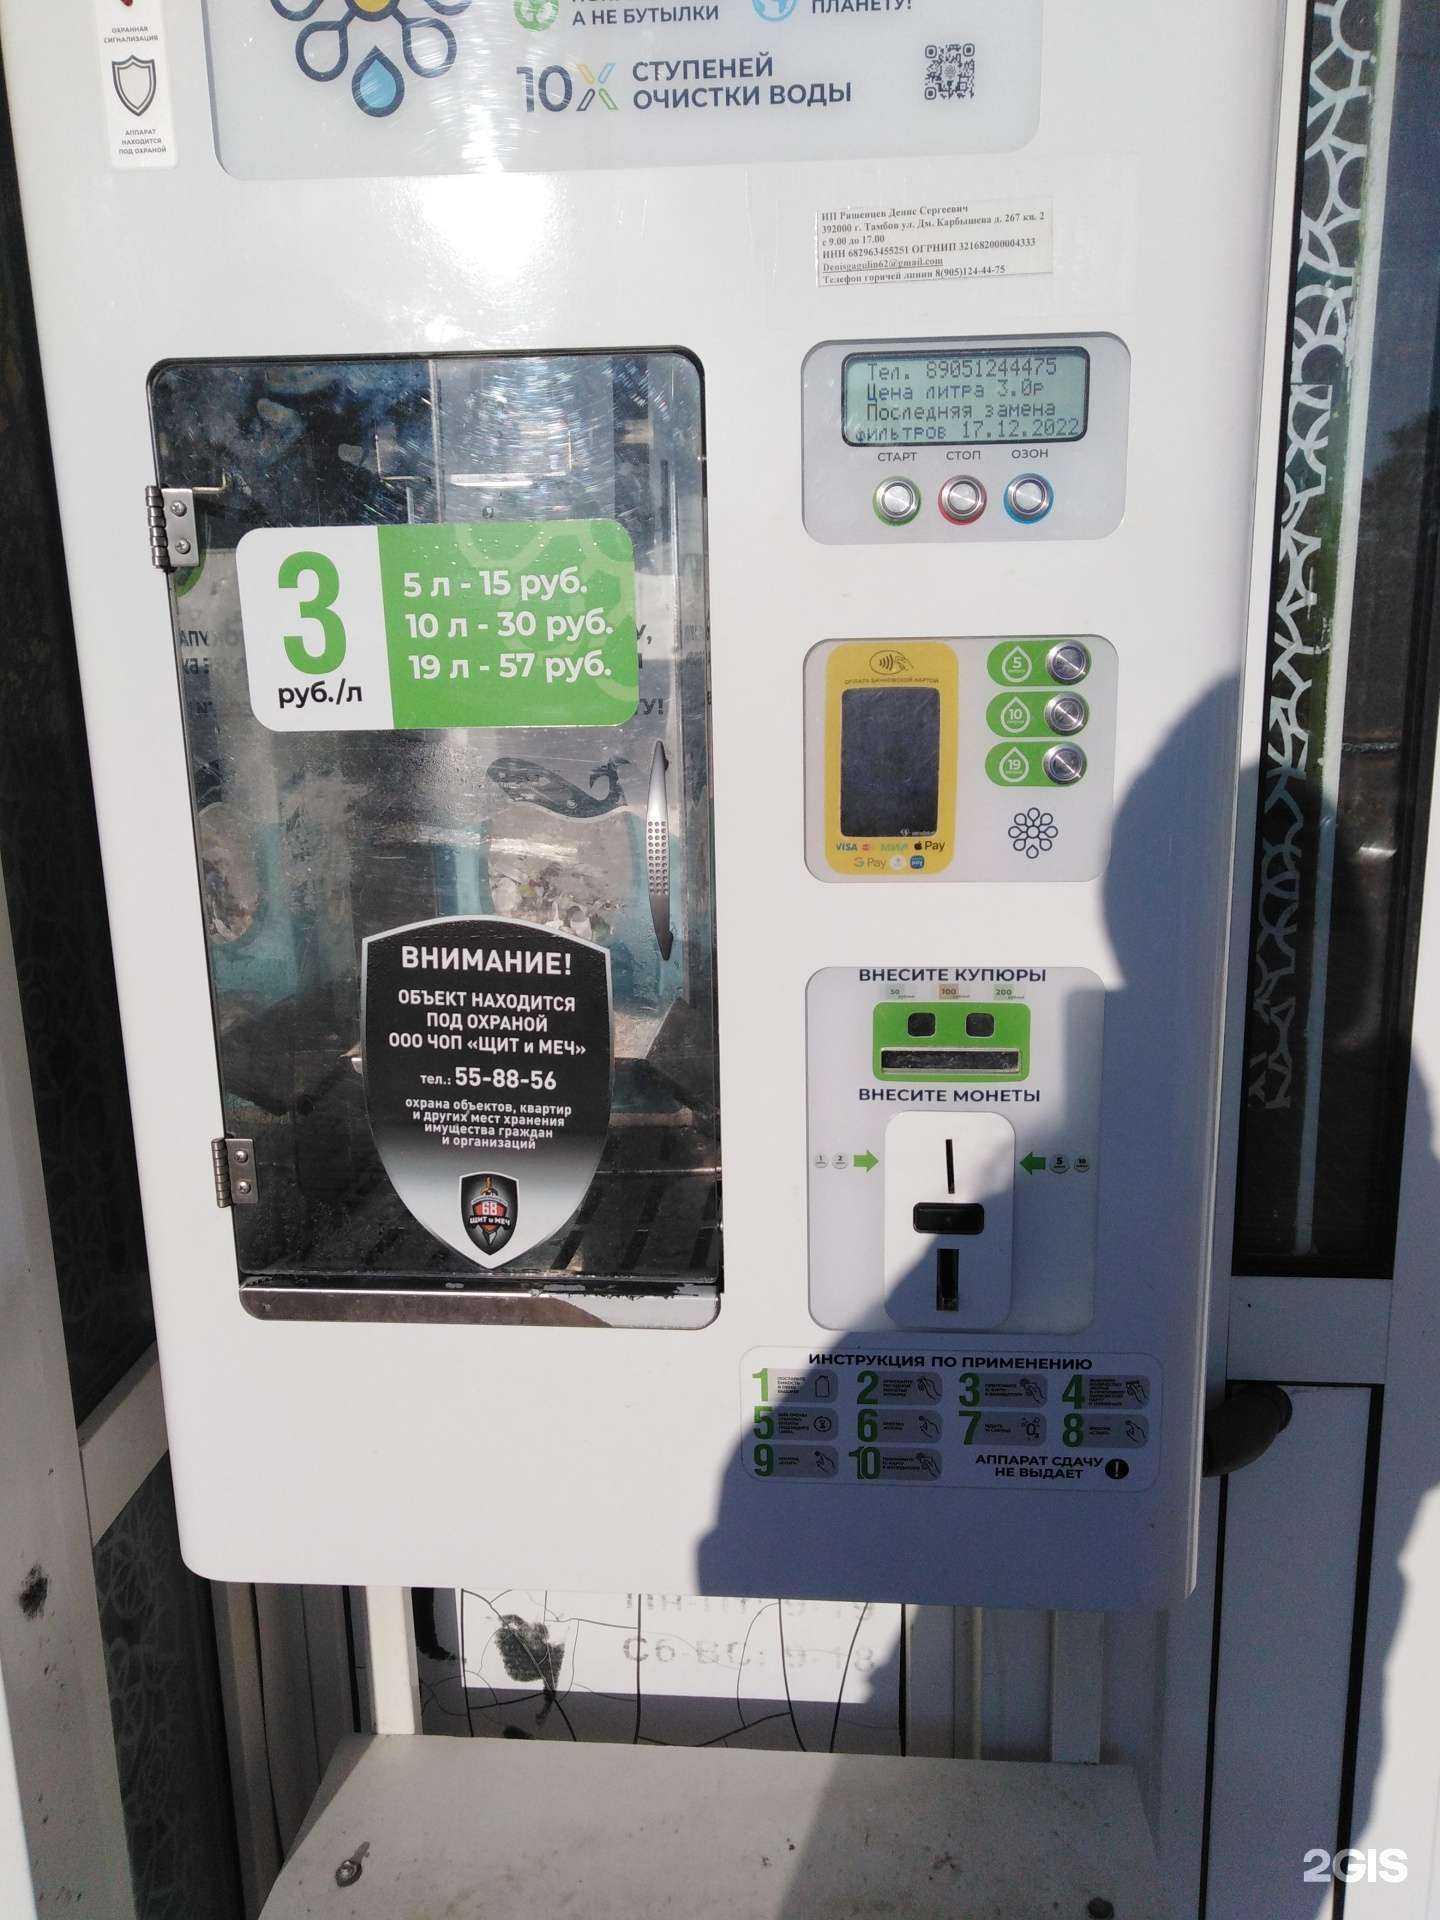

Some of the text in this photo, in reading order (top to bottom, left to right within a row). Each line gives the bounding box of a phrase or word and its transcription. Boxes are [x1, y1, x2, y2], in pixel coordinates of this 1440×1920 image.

[572, 5, 719, 26] А НЕ БУТЫЛКИ
[103, 34, 159, 43] СИГНАЛИЗАЦИЯ
[632, 52, 773, 83] СТУПЕНЕЙ
[633, 82, 852, 110] ОЧИСТКИ ВОДЫ
[118, 146, 167, 156] ПОД ОХРАНОЙ
[121, 138, 162, 146] НАХОДИТСЯ
[822, 211, 837, 221] ИП
[888, 207, 917, 217] Денис
[919, 205, 968, 216] Сергеевич
[822, 223, 852, 234] 392000
[864, 221, 899, 231] Тамбов
[1005, 213, 1021, 222] 267
[829, 237, 847, 246] 9.00
[862, 234, 885, 244] 17.00
[822, 249, 846, 259] ИНН
[824, 275, 862, 285] Телефон
[935, 265, 1006, 279] 8(905)124-44-75
[868, 358, 1057, 381] Тел. 89051244475
[867, 384, 914, 402] Цена
[926, 382, 985, 399] литра
[866, 401, 1056, 421] Последняя замена
[855, 418, 1080, 443] фильтров 17.12.2022
[877, 452, 917, 463] СТАРТ
[946, 450, 981, 461] СТОП
[1011, 448, 1049, 459] ОЗОН
[404, 572, 422, 597] 5
[431, 577, 450, 596] л
[479, 571, 511, 595] 15
[521, 567, 588, 600] руб.
[278, 551, 347, 675] 3
[405, 613, 439, 638] 10
[448, 617, 468, 637] л
[497, 611, 535, 636] 30
[546, 608, 613, 641] руб.
[408, 655, 440, 680] 19
[449, 659, 470, 679] л
[499, 653, 535, 678] 57
[546, 650, 612, 683] руб.
[1012, 657, 1021, 667] 5
[278, 678, 363, 709] руб./л
[1008, 709, 1022, 720] 10
[1008, 759, 1020, 770] 19
[836, 843, 857, 852] VISA
[924, 841, 945, 852] Pay
[867, 857, 886, 869] Pay
[402, 946, 572, 975] ВНИМАНИЕ!
[859, 969, 1046, 982] ВНЕСИТЕ КУПЮРЫ
[398, 989, 576, 1012] ОБЪЕКТ НАХОДИТСЯ
[427, 1013, 548, 1032] ПОД ОХРАНОЙ
[389, 1033, 586, 1055] ООО ЧОП «ЩИТ и МЕЧ»
[420, 1067, 557, 1090] тел.: 55-88-56
[859, 1089, 1040, 1102] ВНЕСИТЕ МОНЕТЫ
[405, 1098, 572, 1116] охрана объектов, квартир
[413, 1110, 565, 1127] и других мест хранения
[424, 1123, 553, 1139] имущества граждан
[442, 1136, 536, 1150] и организаций
[809, 1353, 1092, 1370] ИНСТРУКЦИЯ ПО ПРИМЕНЕНИЮ
[752, 1368, 768, 1402] 1
[857, 1370, 879, 1404] 2
[959, 1372, 980, 1407] 3
[1062, 1374, 1085, 1409] 4
[754, 1406, 774, 1440] 5
[857, 1409, 878, 1442] 6
[958, 1411, 981, 1445] 7
[1062, 1413, 1084, 1447] 8
[754, 1443, 774, 1476] 9
[849, 1446, 880, 1480] 10
[976, 1455, 1103, 1469] АППАРАТ СДАЧУ
[995, 1467, 1083, 1480] НЕ ВЫДАЕТ
